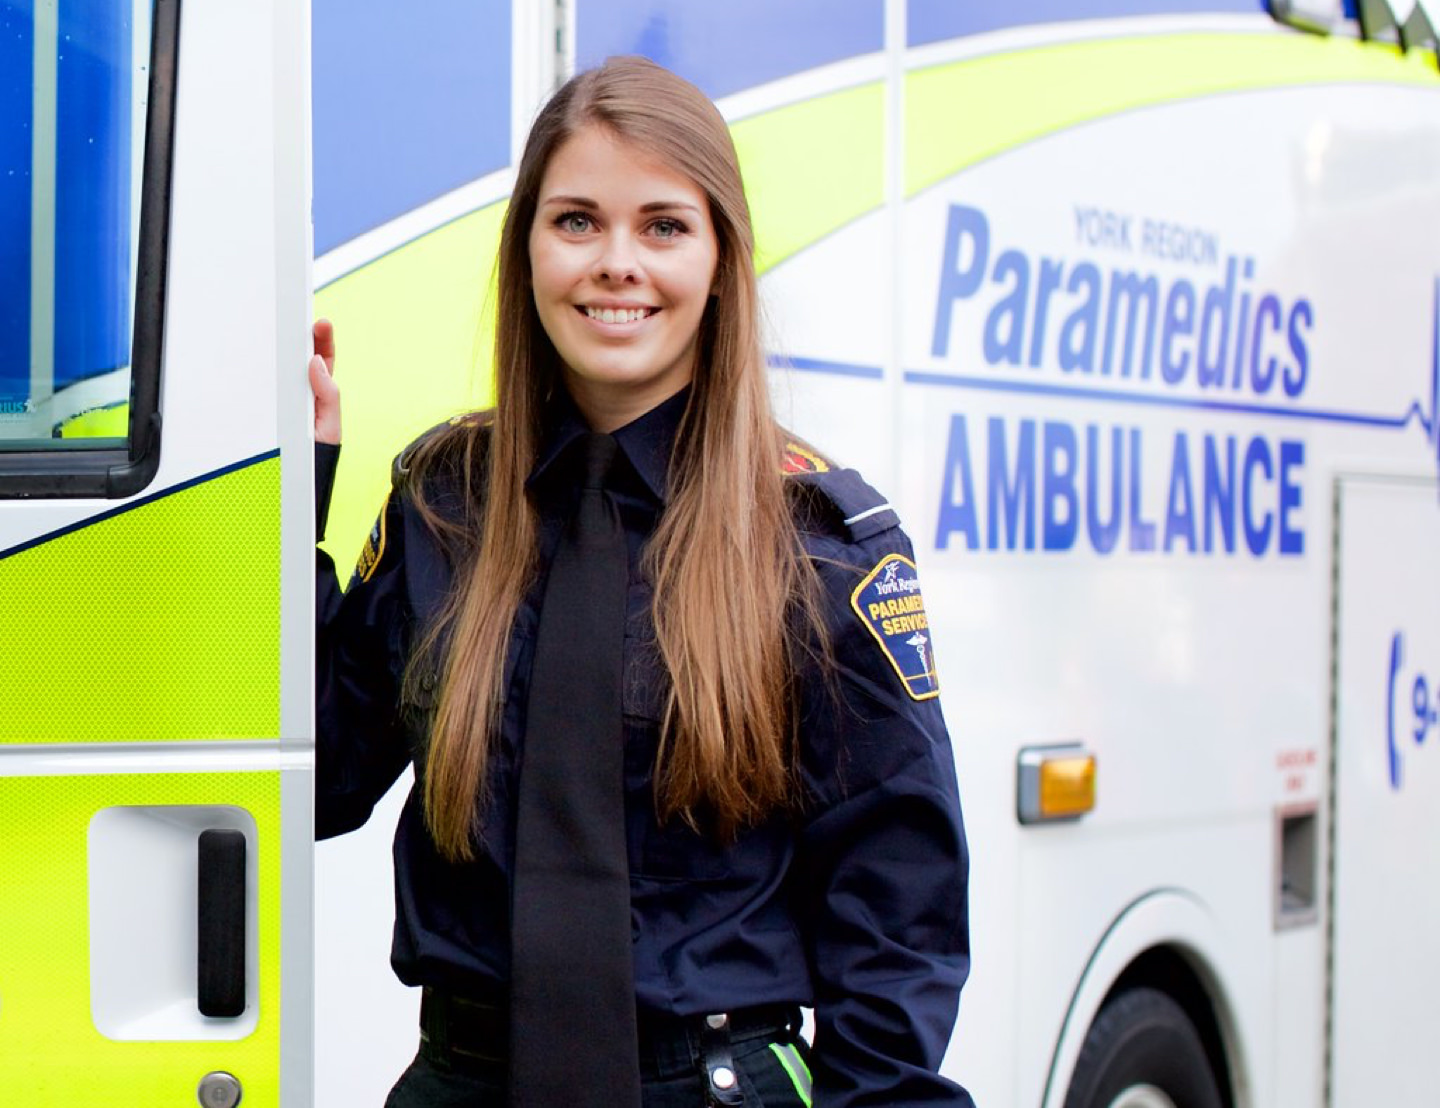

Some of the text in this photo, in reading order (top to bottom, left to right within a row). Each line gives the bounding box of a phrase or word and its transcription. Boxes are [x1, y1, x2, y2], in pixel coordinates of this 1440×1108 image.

[1074, 204, 1219, 266] YORK REGION
[931, 202, 1313, 397] Paramedics
[934, 412, 1306, 557] AMBULANCE
[882, 613, 928, 636] SERVIC
